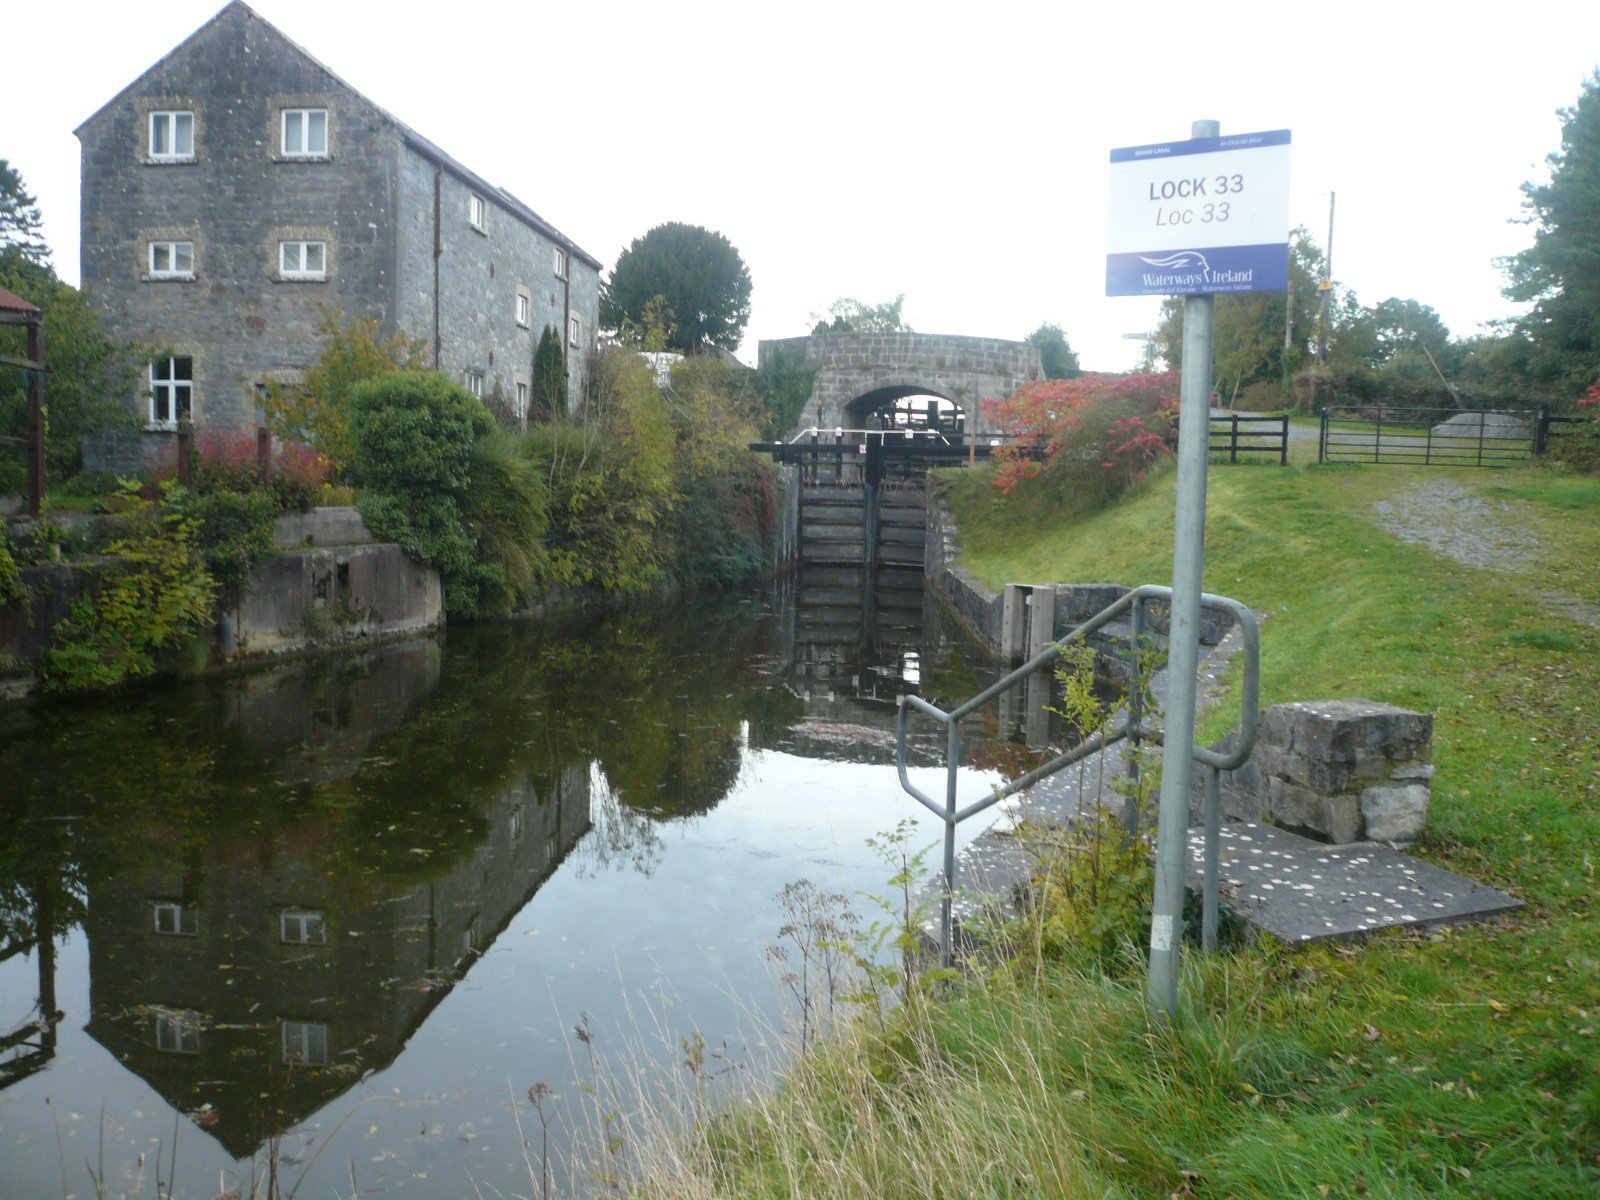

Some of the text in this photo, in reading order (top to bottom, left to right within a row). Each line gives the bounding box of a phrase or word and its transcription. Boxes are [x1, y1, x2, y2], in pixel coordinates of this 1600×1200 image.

[1149, 174, 1244, 201] LOCK 33
[1200, 202, 1231, 223] 33
[1143, 268, 1253, 287] Waterways Ireland
